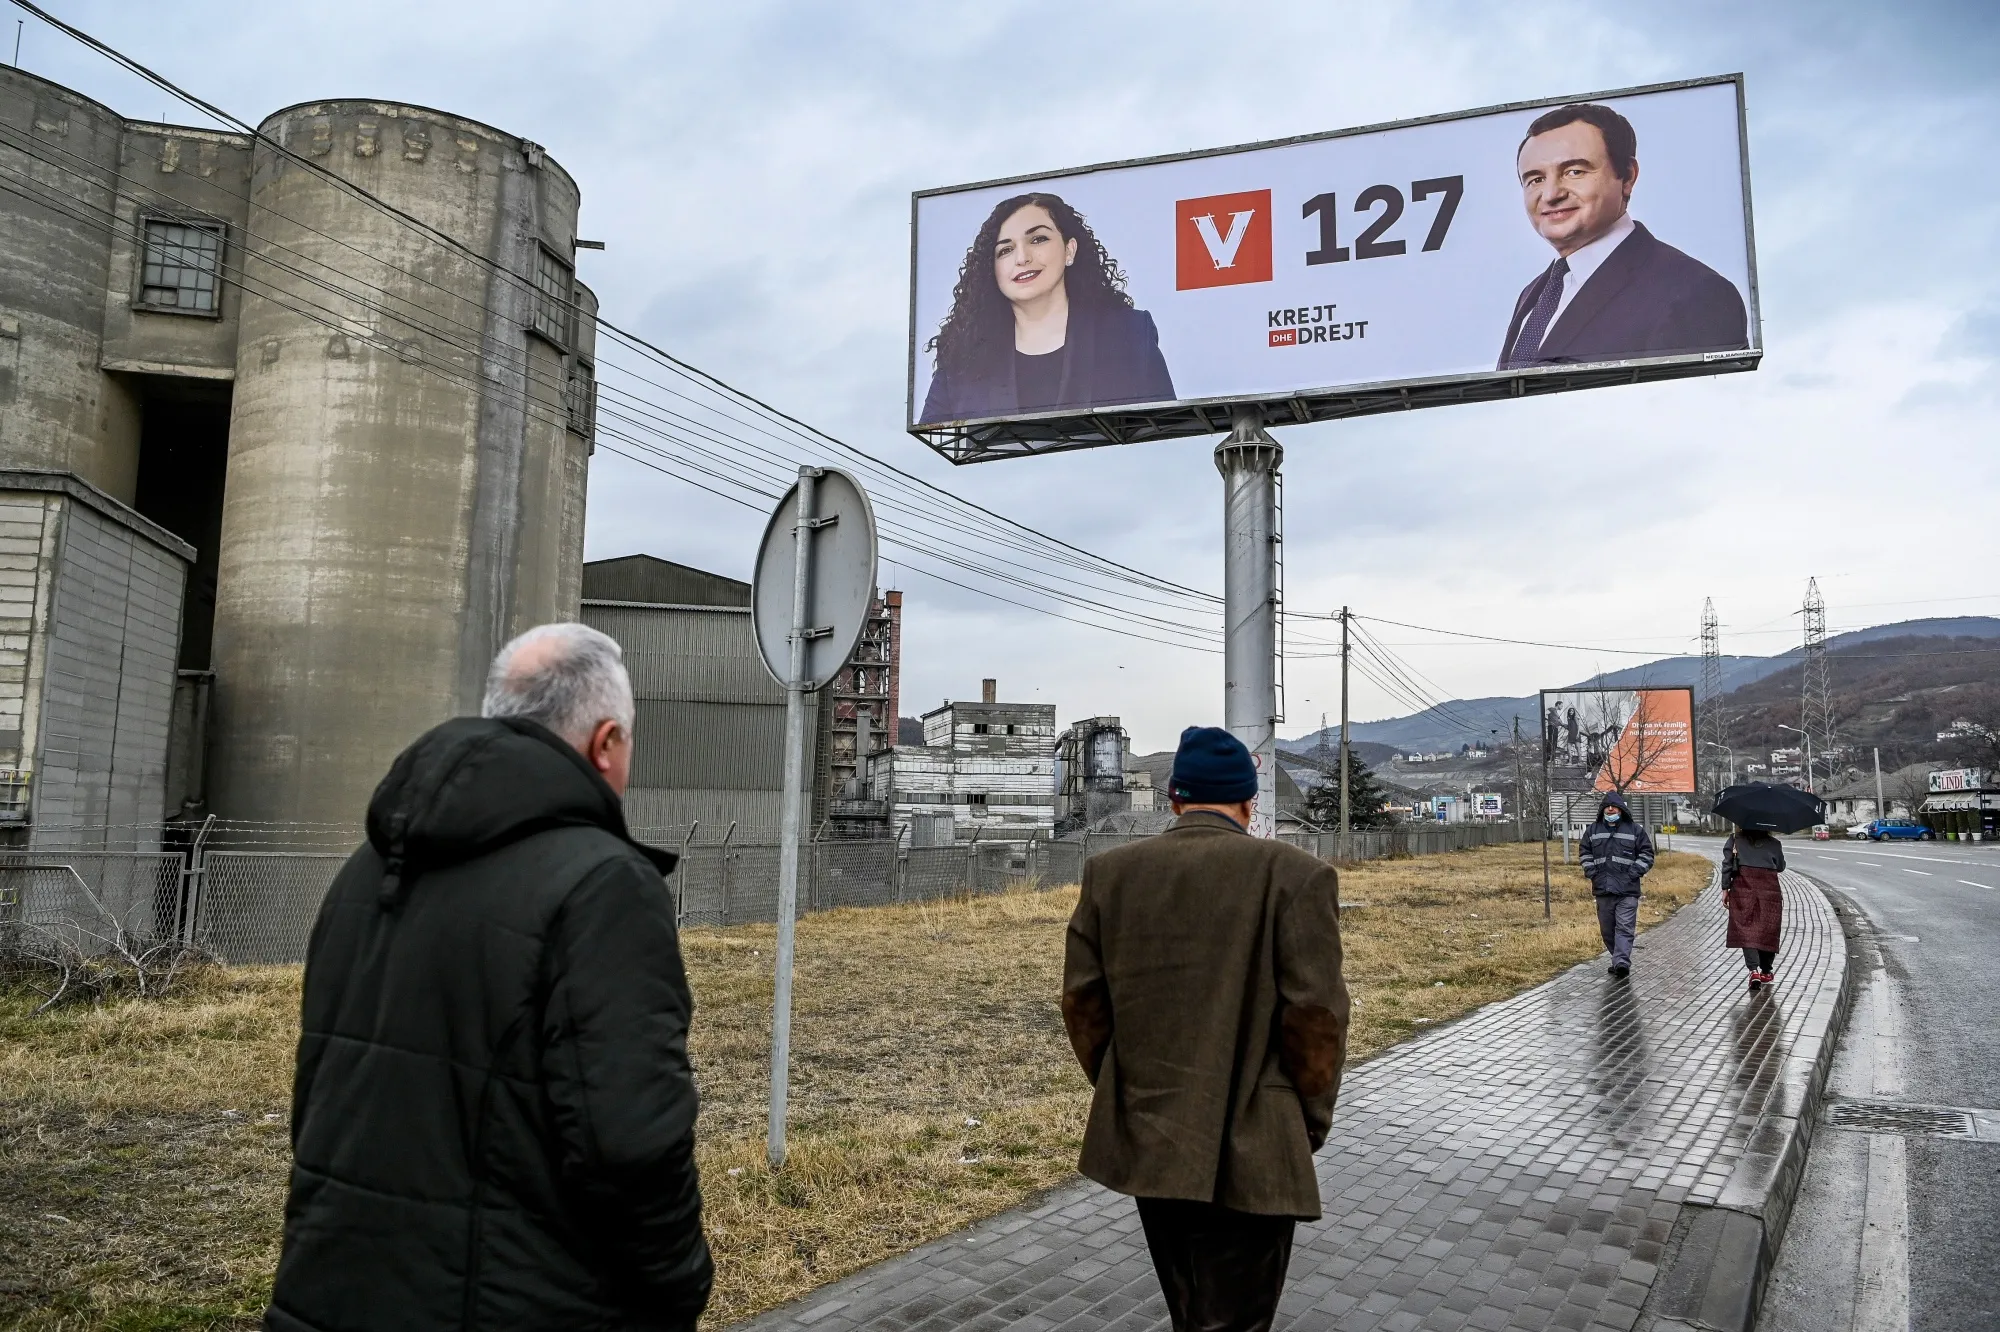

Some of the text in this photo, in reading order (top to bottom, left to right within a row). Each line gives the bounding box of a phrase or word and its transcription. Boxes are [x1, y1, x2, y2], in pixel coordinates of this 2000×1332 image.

[1190, 174, 1464, 270] V 127
[1268, 304, 1337, 328] KREJT
[1272, 321, 1369, 345] DHE DREJT
[1941, 775, 1963, 790] LINDI
